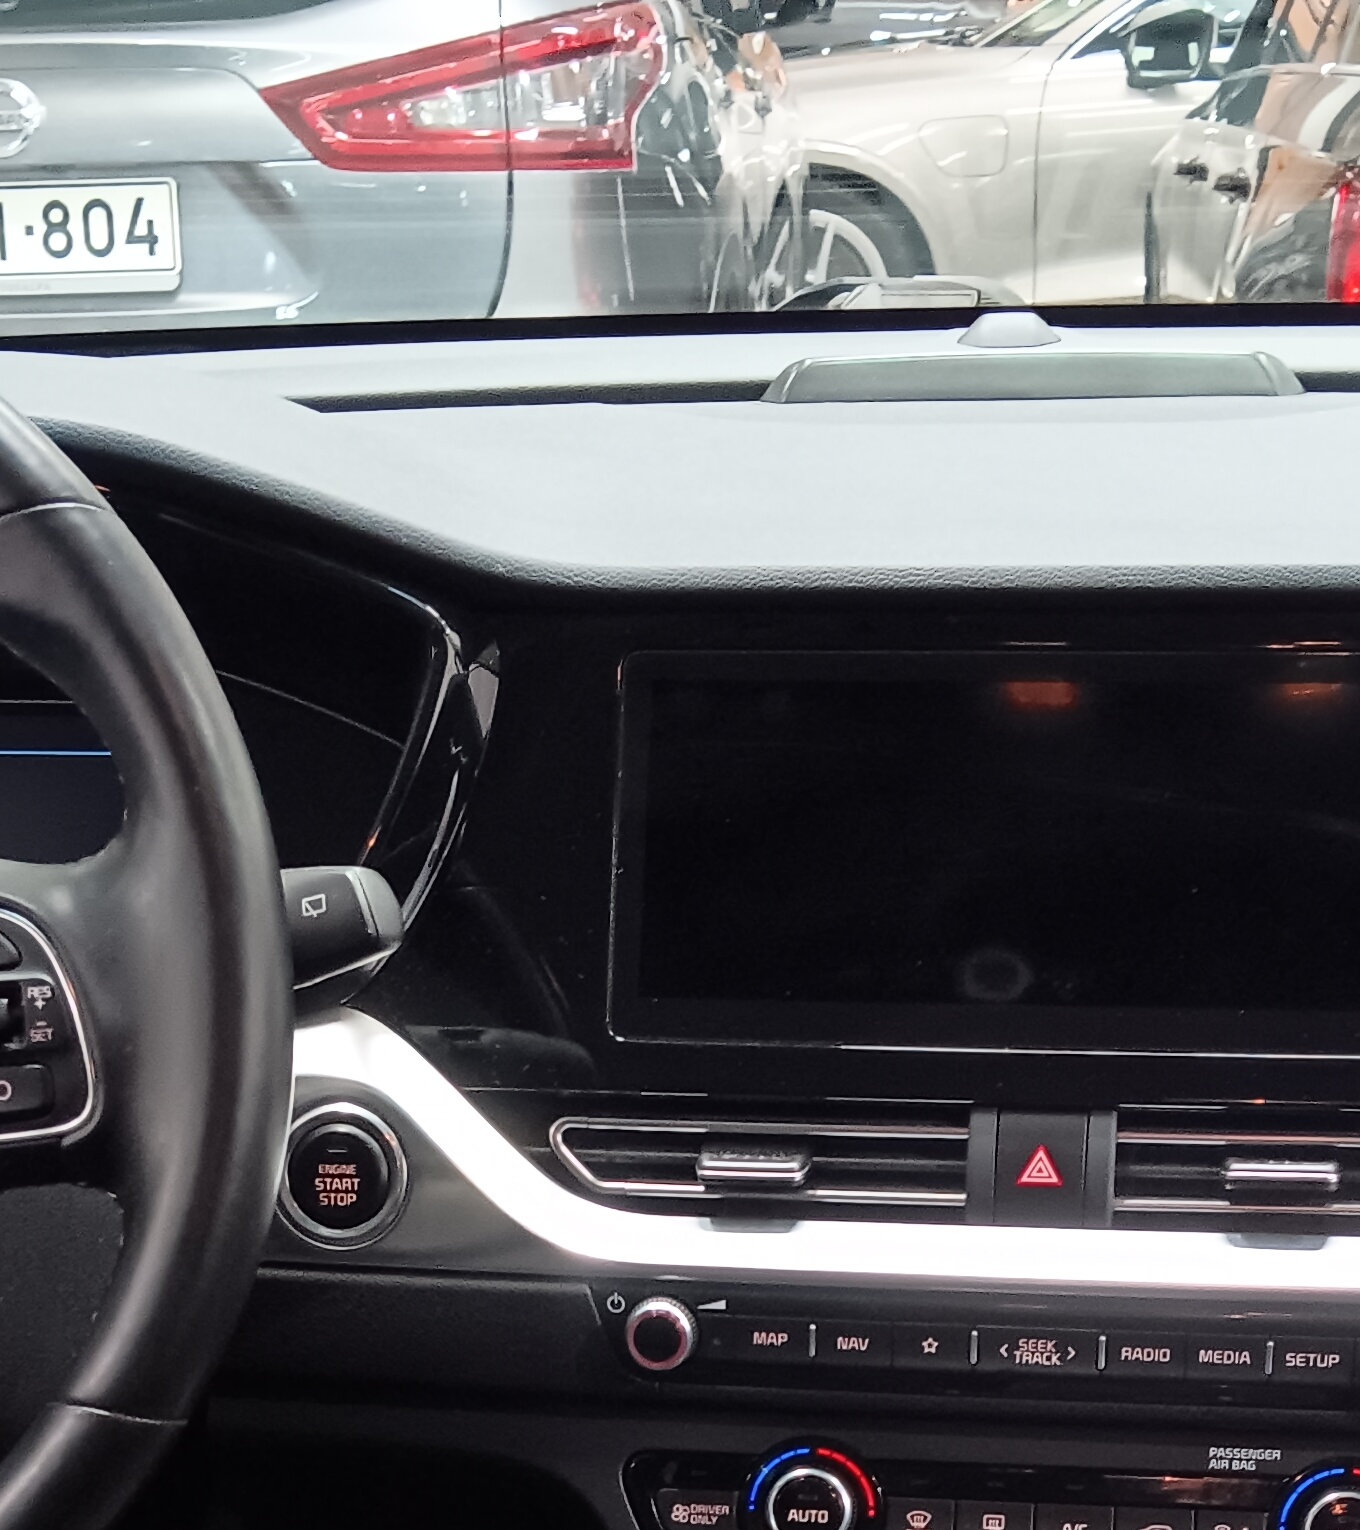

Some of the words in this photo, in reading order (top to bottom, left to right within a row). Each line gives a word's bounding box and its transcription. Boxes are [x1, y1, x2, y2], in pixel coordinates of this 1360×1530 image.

[27, 985, 52, 999] RES
[29, 1028, 54, 1043] SET
[318, 1163, 357, 1175] ENGINE
[314, 1177, 360, 1191] START
[319, 1192, 357, 1207] STOP
[753, 1331, 789, 1346] MAP
[836, 1336, 869, 1351] NAV
[1018, 1338, 1058, 1352] SEEK
[1013, 1350, 1061, 1366] TRACK
[1121, 1347, 1171, 1362] RADIO
[1198, 1349, 1252, 1365] MEDIA
[1285, 1352, 1340, 1368] SETUP
[1208, 1446, 1281, 1461] PASSENGER
[1208, 1459, 1229, 1470] AIR
[1231, 1459, 1256, 1471] BAG
[690, 1503, 730, 1516] DRIVER
[787, 1508, 829, 1524] AUTO
[690, 1514, 719, 1525] ONLY
